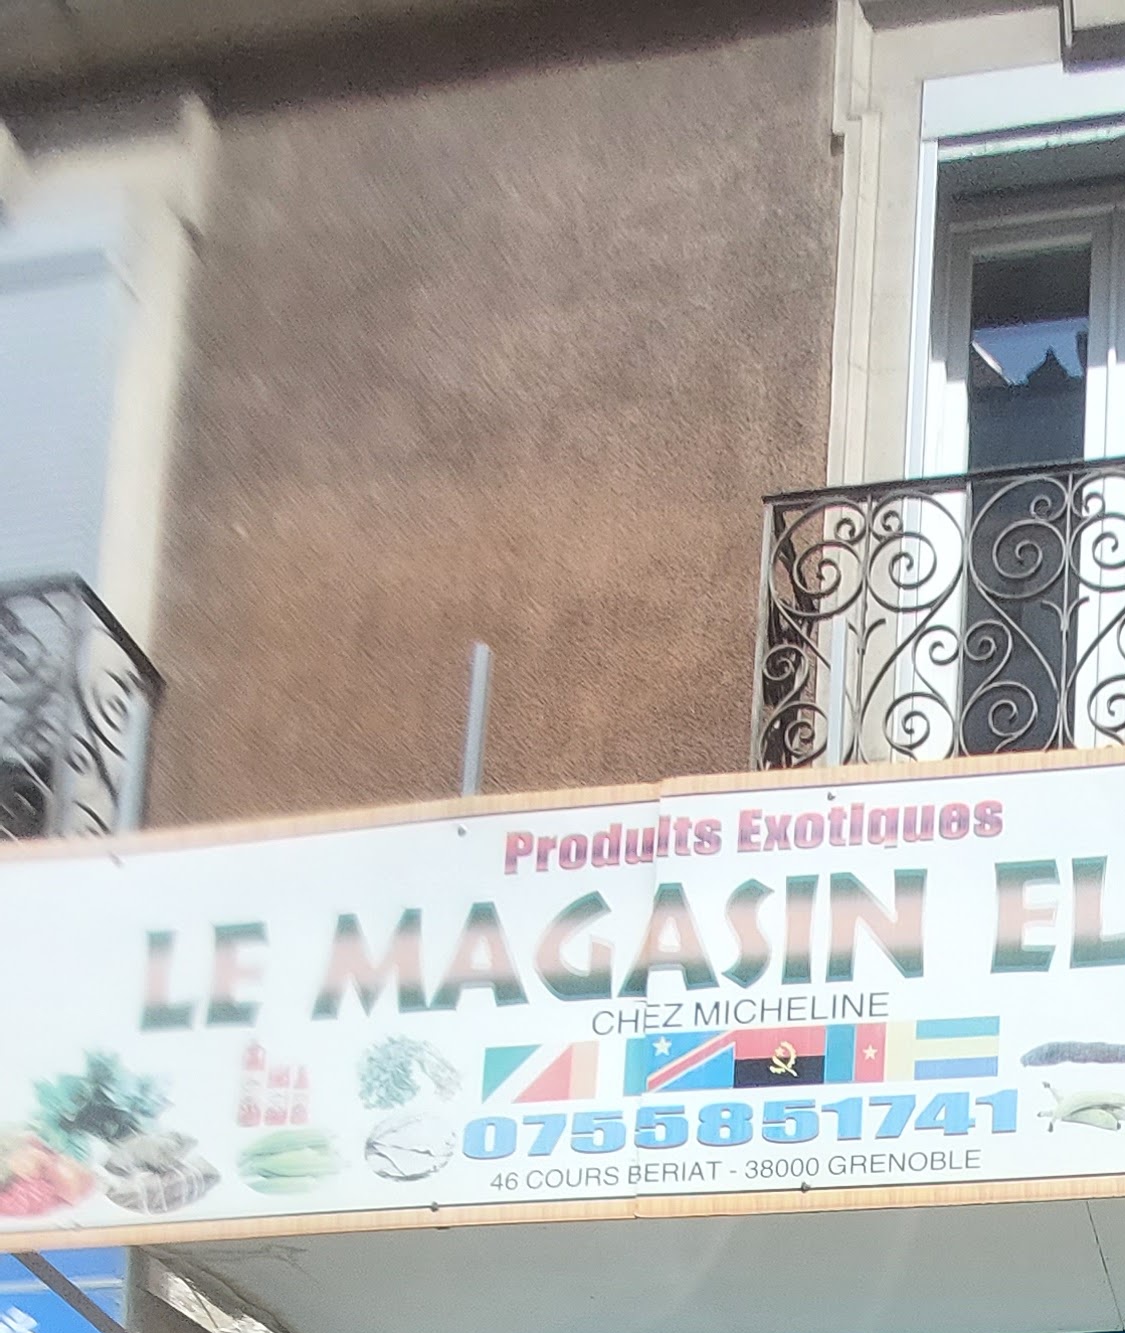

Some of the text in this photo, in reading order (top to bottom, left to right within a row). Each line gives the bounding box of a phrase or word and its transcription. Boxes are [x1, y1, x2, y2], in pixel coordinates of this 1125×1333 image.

[504, 799, 1004, 875] Produits Exotiques
[138, 920, 270, 1033] LE
[310, 868, 929, 1021] MAGASIN
[591, 992, 890, 1038] CHEZ MICHELINE
[460, 1088, 1019, 1160] 0755851741
[489, 1171, 520, 1192] 46
[525, 1166, 620, 1190] COURS
[626, 1160, 723, 1186] BERIAT
[742, 1156, 820, 1181] 38000
[827, 1149, 983, 1177] GRENOBLE
